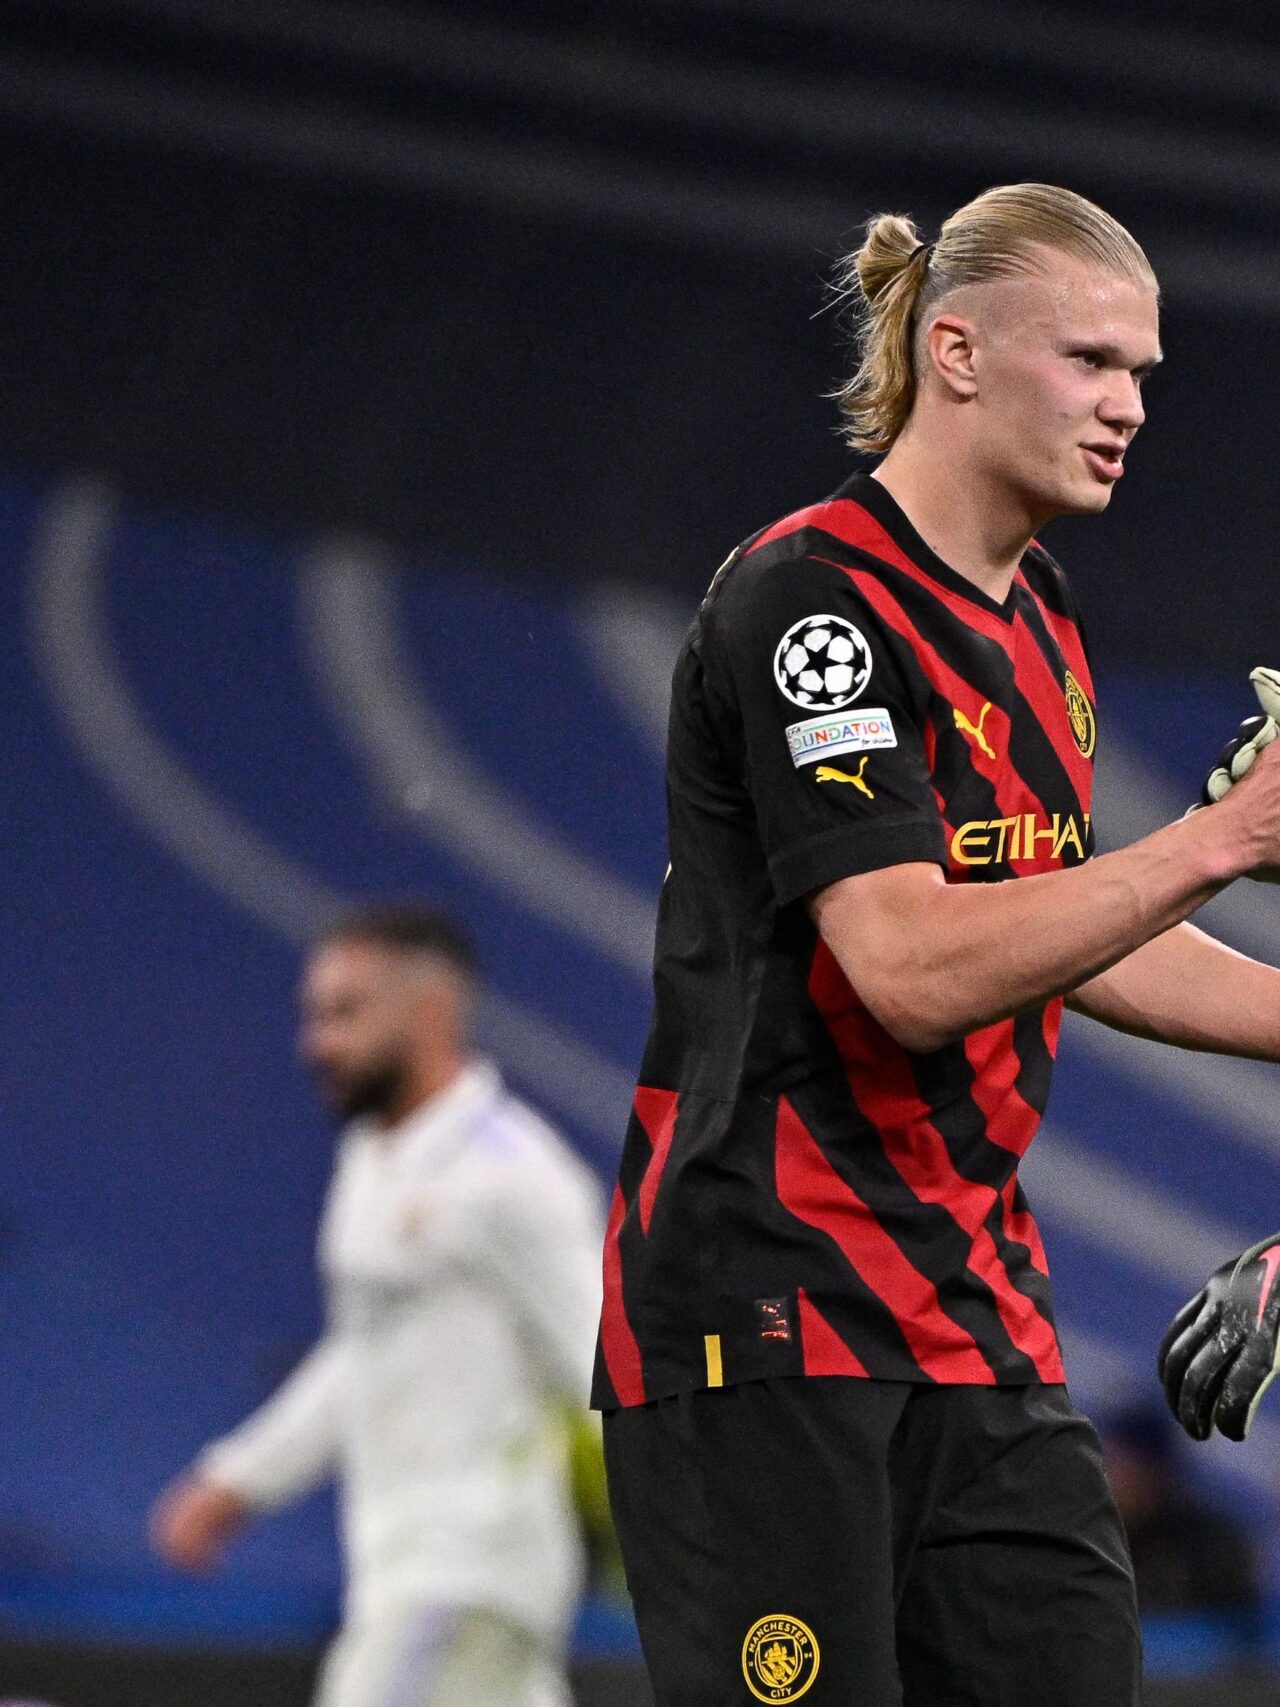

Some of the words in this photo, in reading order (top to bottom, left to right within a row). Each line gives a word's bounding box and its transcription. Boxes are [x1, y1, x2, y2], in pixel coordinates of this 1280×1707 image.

[788, 720, 890, 750] OUNDATION
[951, 813, 1090, 865] ETIHA
[749, 1622, 808, 1652] MANCHESTER
[770, 1687, 792, 1698] CITY
